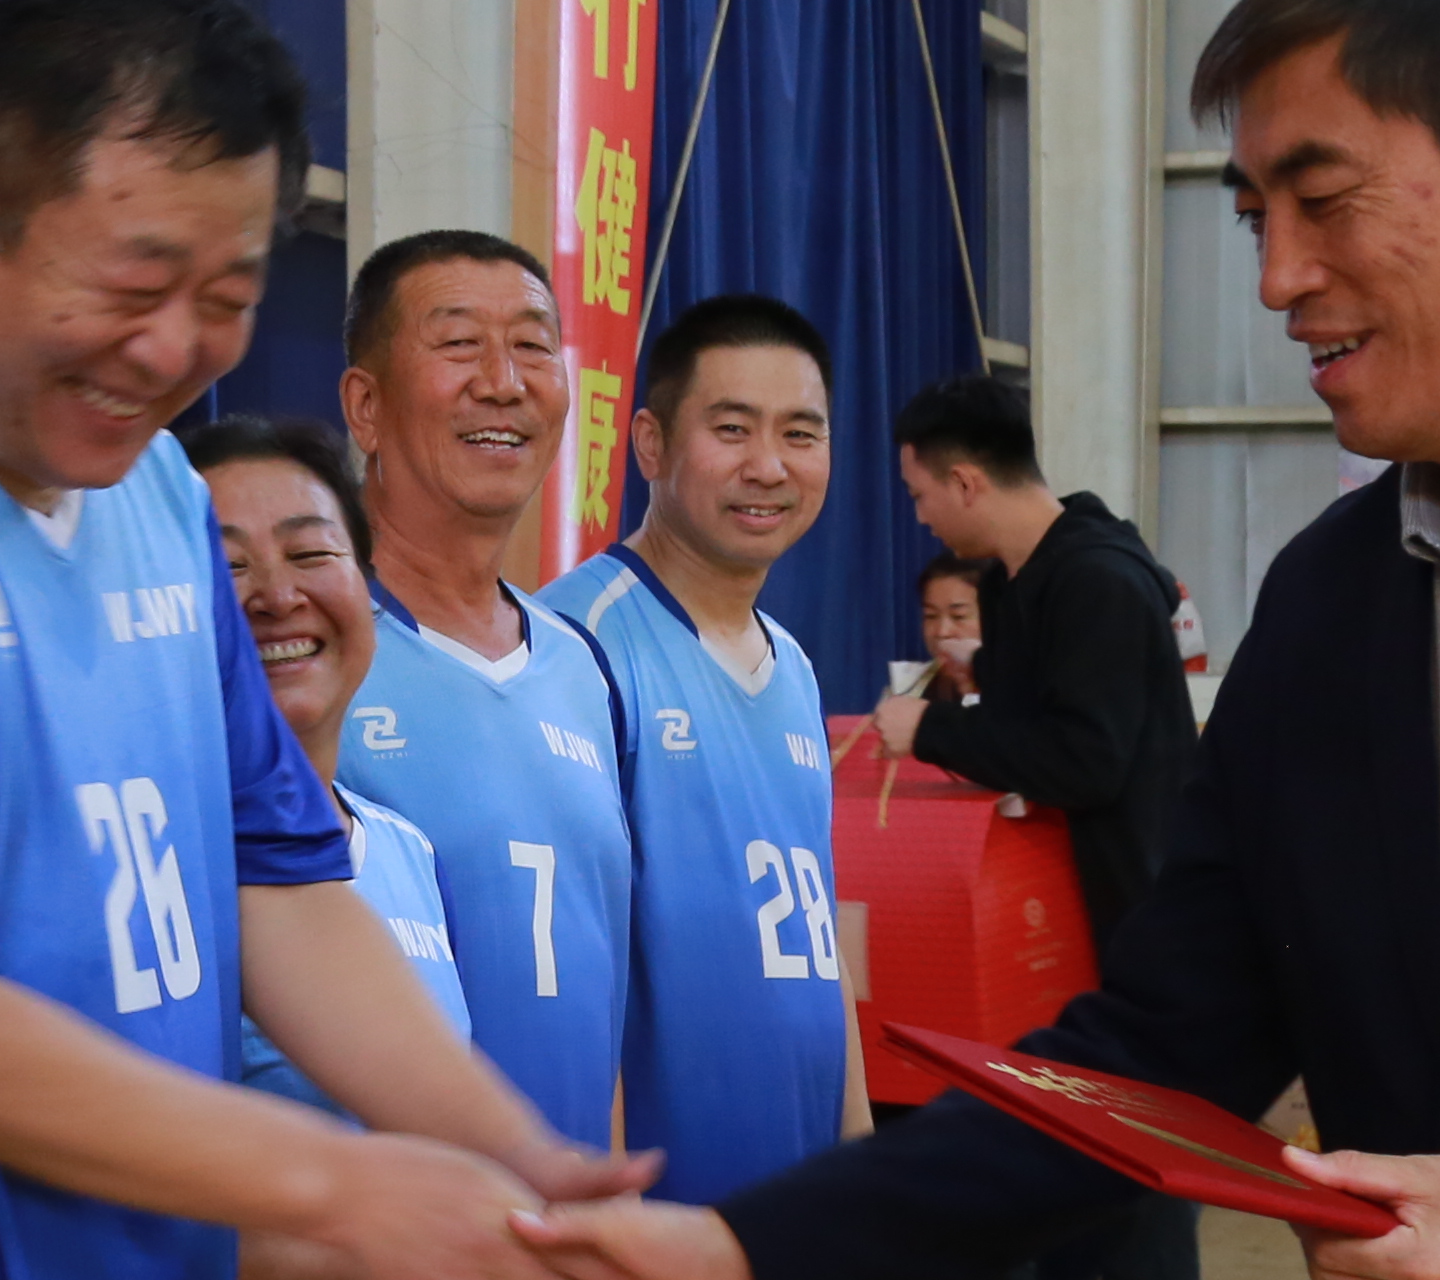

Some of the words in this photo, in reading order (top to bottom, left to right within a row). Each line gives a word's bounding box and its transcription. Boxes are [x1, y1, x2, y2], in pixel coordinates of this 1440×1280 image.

[100, 582, 198, 643] WJWY
[538, 720, 603, 773] WJWY
[74, 776, 201, 1014] 26
[508, 839, 558, 997] 7
[745, 839, 841, 981] 28
